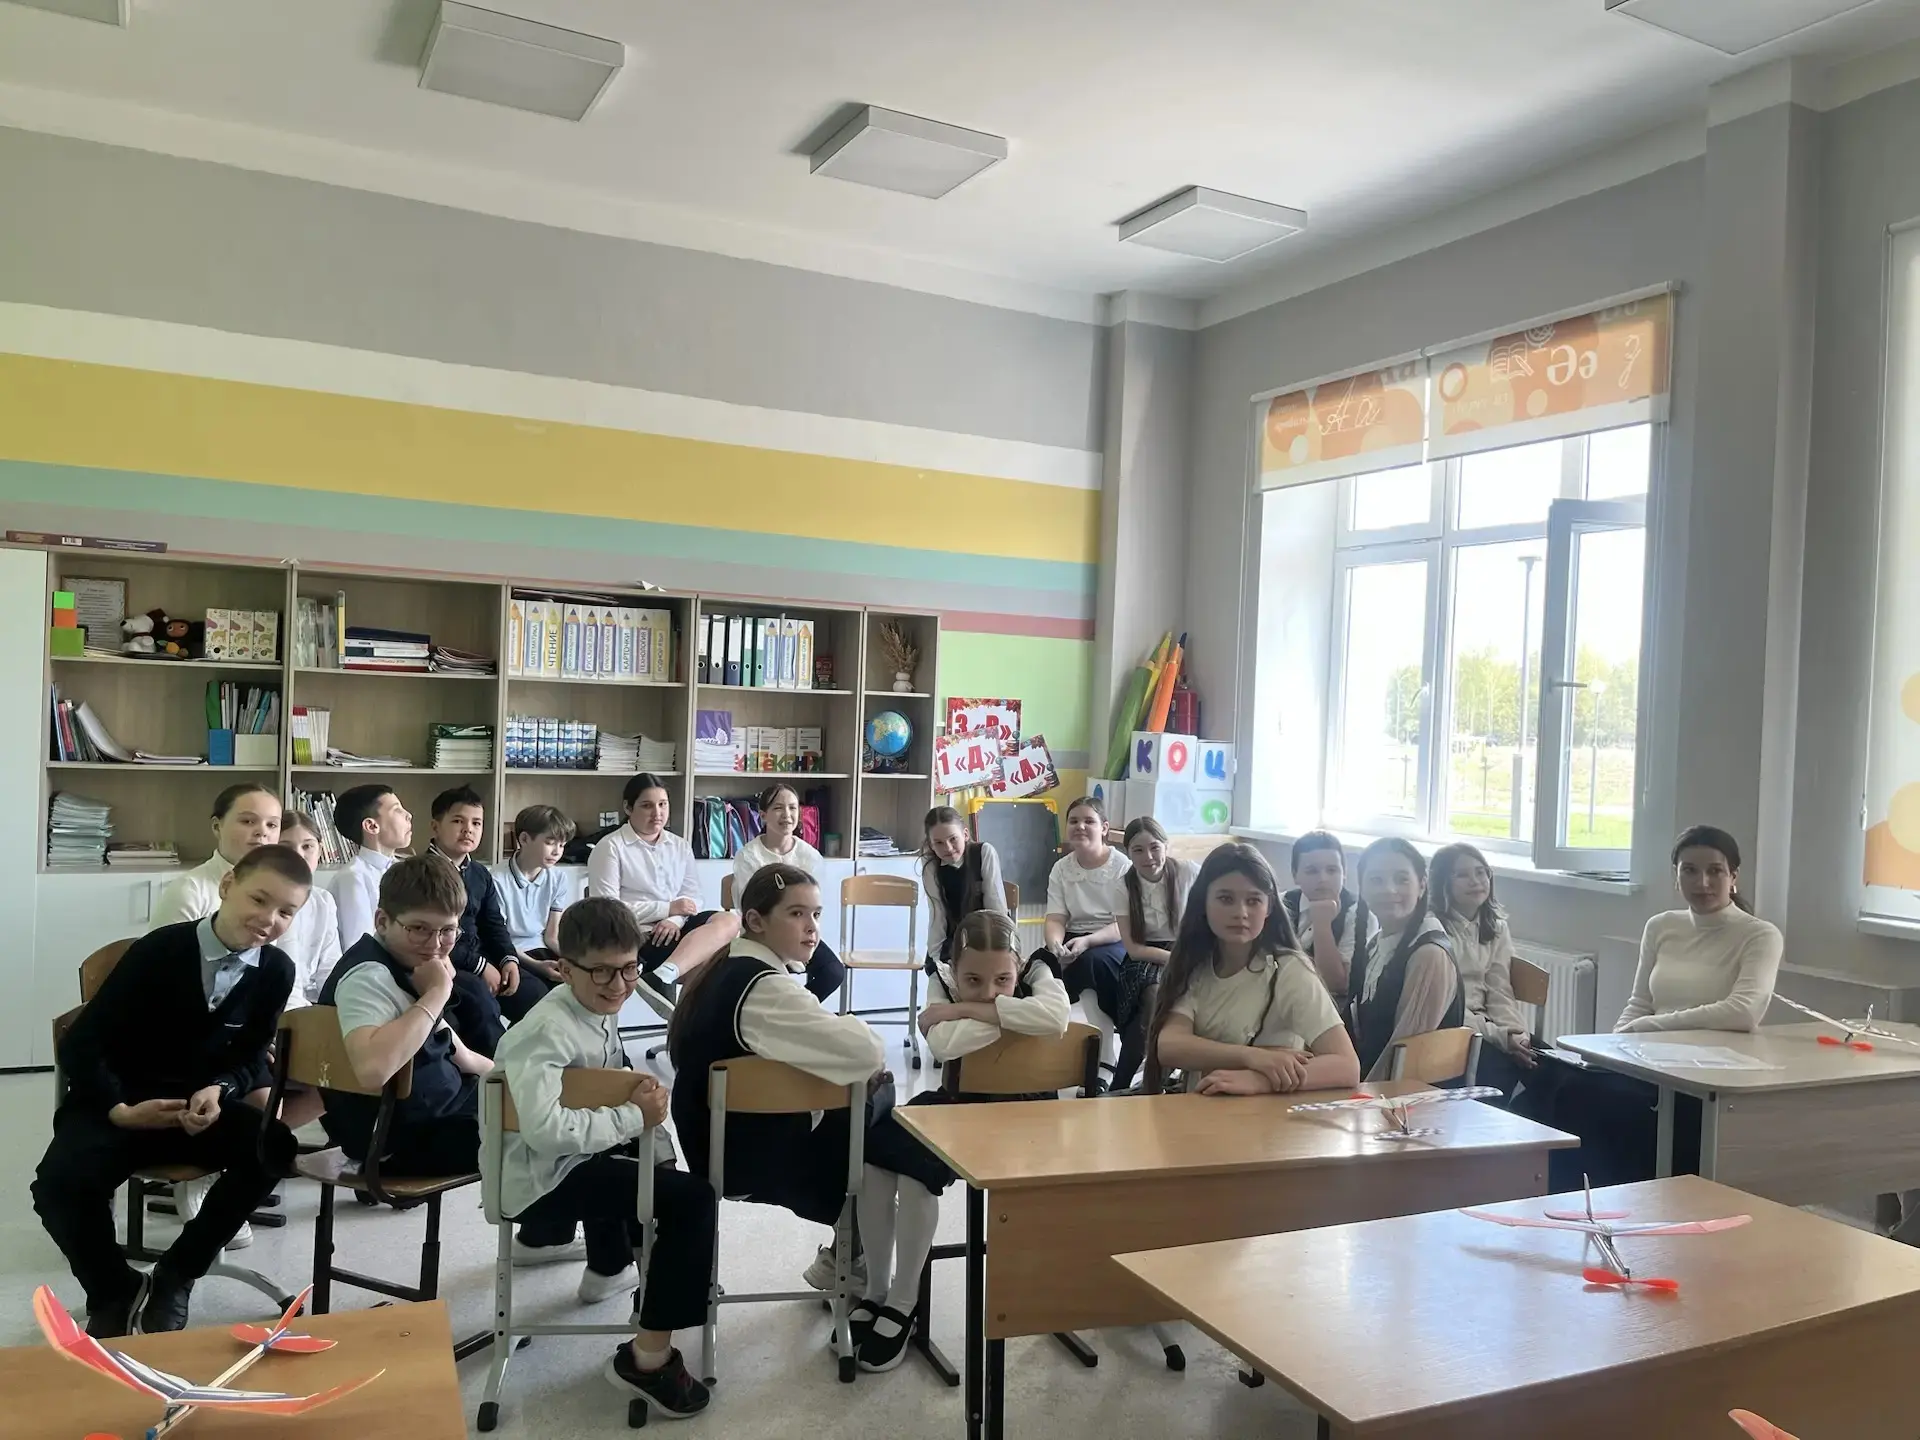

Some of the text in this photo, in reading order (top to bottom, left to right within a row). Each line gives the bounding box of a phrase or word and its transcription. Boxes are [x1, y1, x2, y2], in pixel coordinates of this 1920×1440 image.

[530, 624, 539, 666] МАТЕМАТИКА
[548, 629, 557, 667] ЧТЕНИЕ
[938, 751, 950, 776] 1
[1136, 738, 1226, 780] К О Ц
